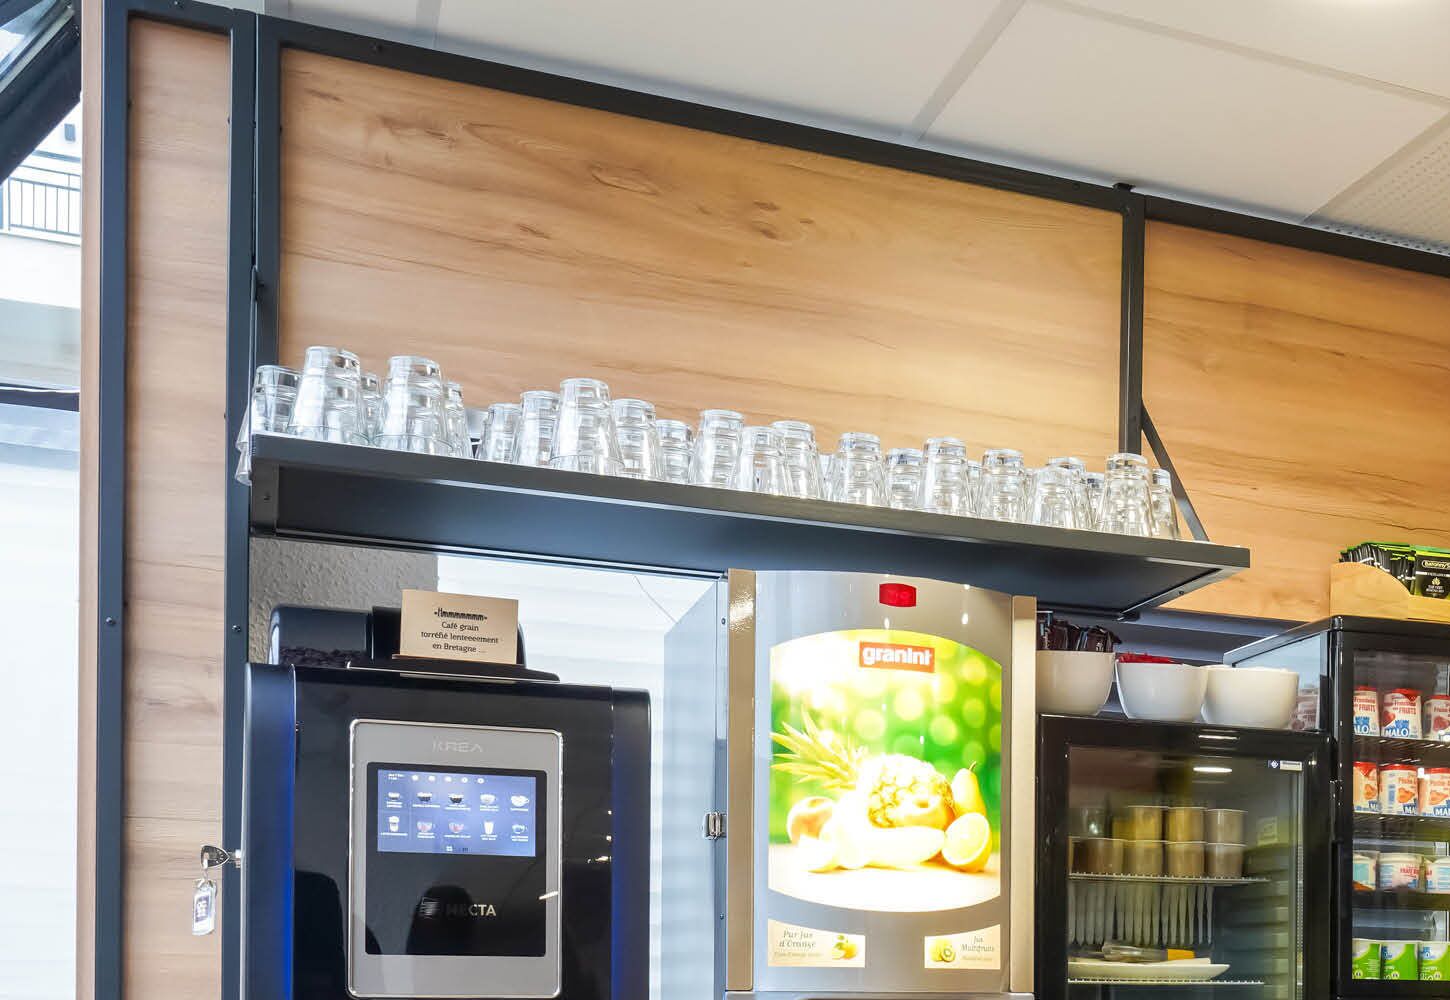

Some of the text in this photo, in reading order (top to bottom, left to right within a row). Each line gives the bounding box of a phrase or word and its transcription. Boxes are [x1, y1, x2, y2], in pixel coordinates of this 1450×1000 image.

[441, 621, 479, 632] Café grain
[421, 630, 449, 640] torréfié
[443, 642, 477, 653] Bretagne
[862, 647, 932, 666] granini
[1384, 727, 1409, 738] MALO
